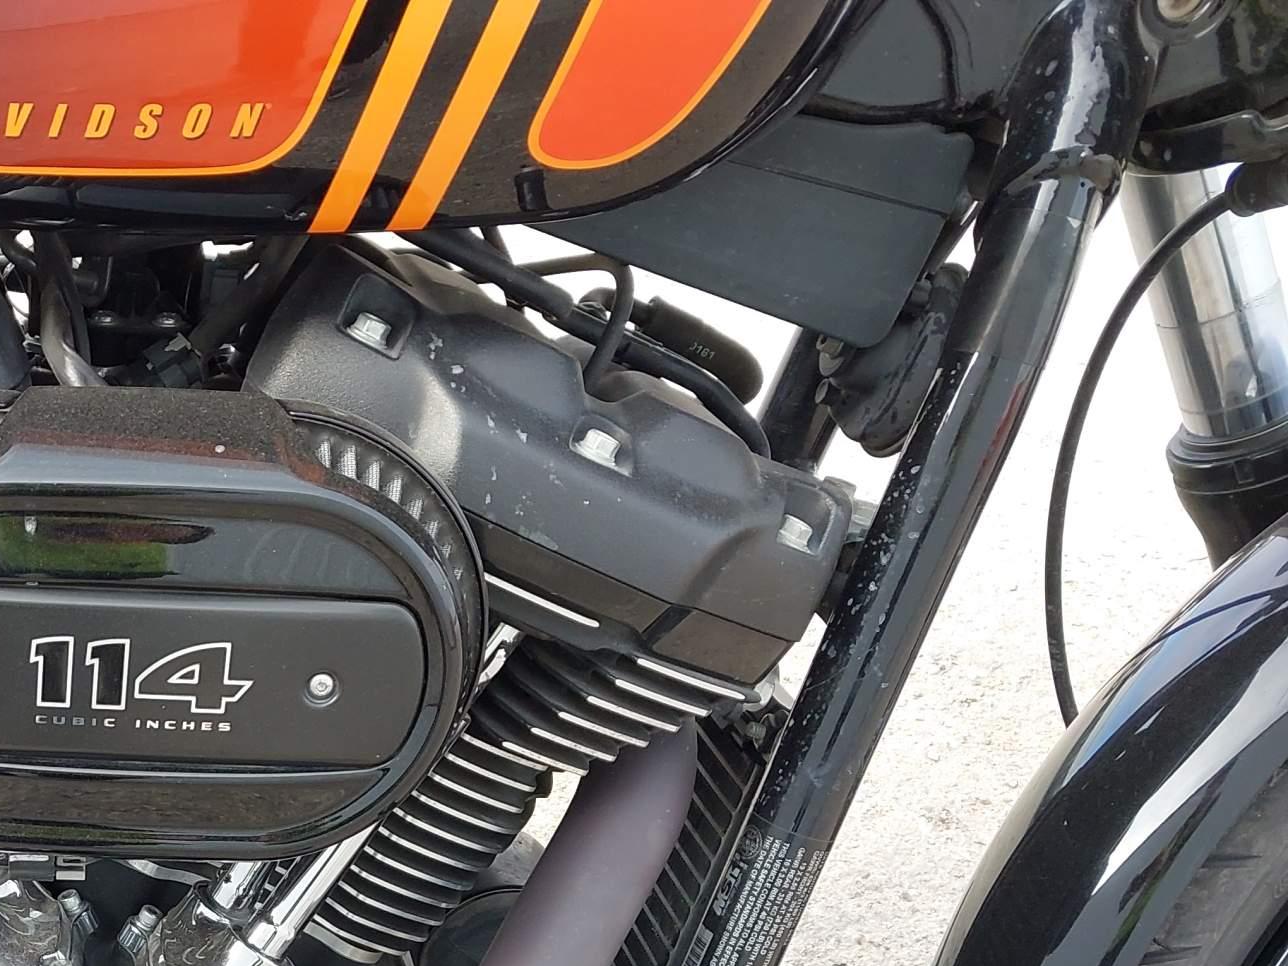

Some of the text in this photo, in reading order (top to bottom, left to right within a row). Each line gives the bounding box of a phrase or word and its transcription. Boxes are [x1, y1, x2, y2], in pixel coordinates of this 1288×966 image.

[29, 635, 255, 714] 114
[35, 715, 232, 731] CUBIC INCHES
[761, 834, 773, 851] THE
[777, 841, 790, 859] THIS
[753, 849, 767, 869] DATE
[762, 837, 782, 869] VEHICLE
[748, 868, 758, 879] OF
[750, 867, 768, 895] SAFETY
[763, 857, 782, 889] VEHICLE
[782, 868, 795, 888] REAR
[724, 879, 754, 931] MANUFACTURE
[745, 887, 769, 927] CONFORMS
[763, 900, 772, 911] AT
[731, 894, 756, 937] STANDARDS
[728, 936, 736, 945] IN
[740, 927, 750, 938] TO
[744, 931, 758, 952] COLD
[713, 930, 730, 957] SHOWN
[734, 937, 745, 952] ALL
[748, 943, 761, 961] WITH
[759, 934, 773, 955] COLD
